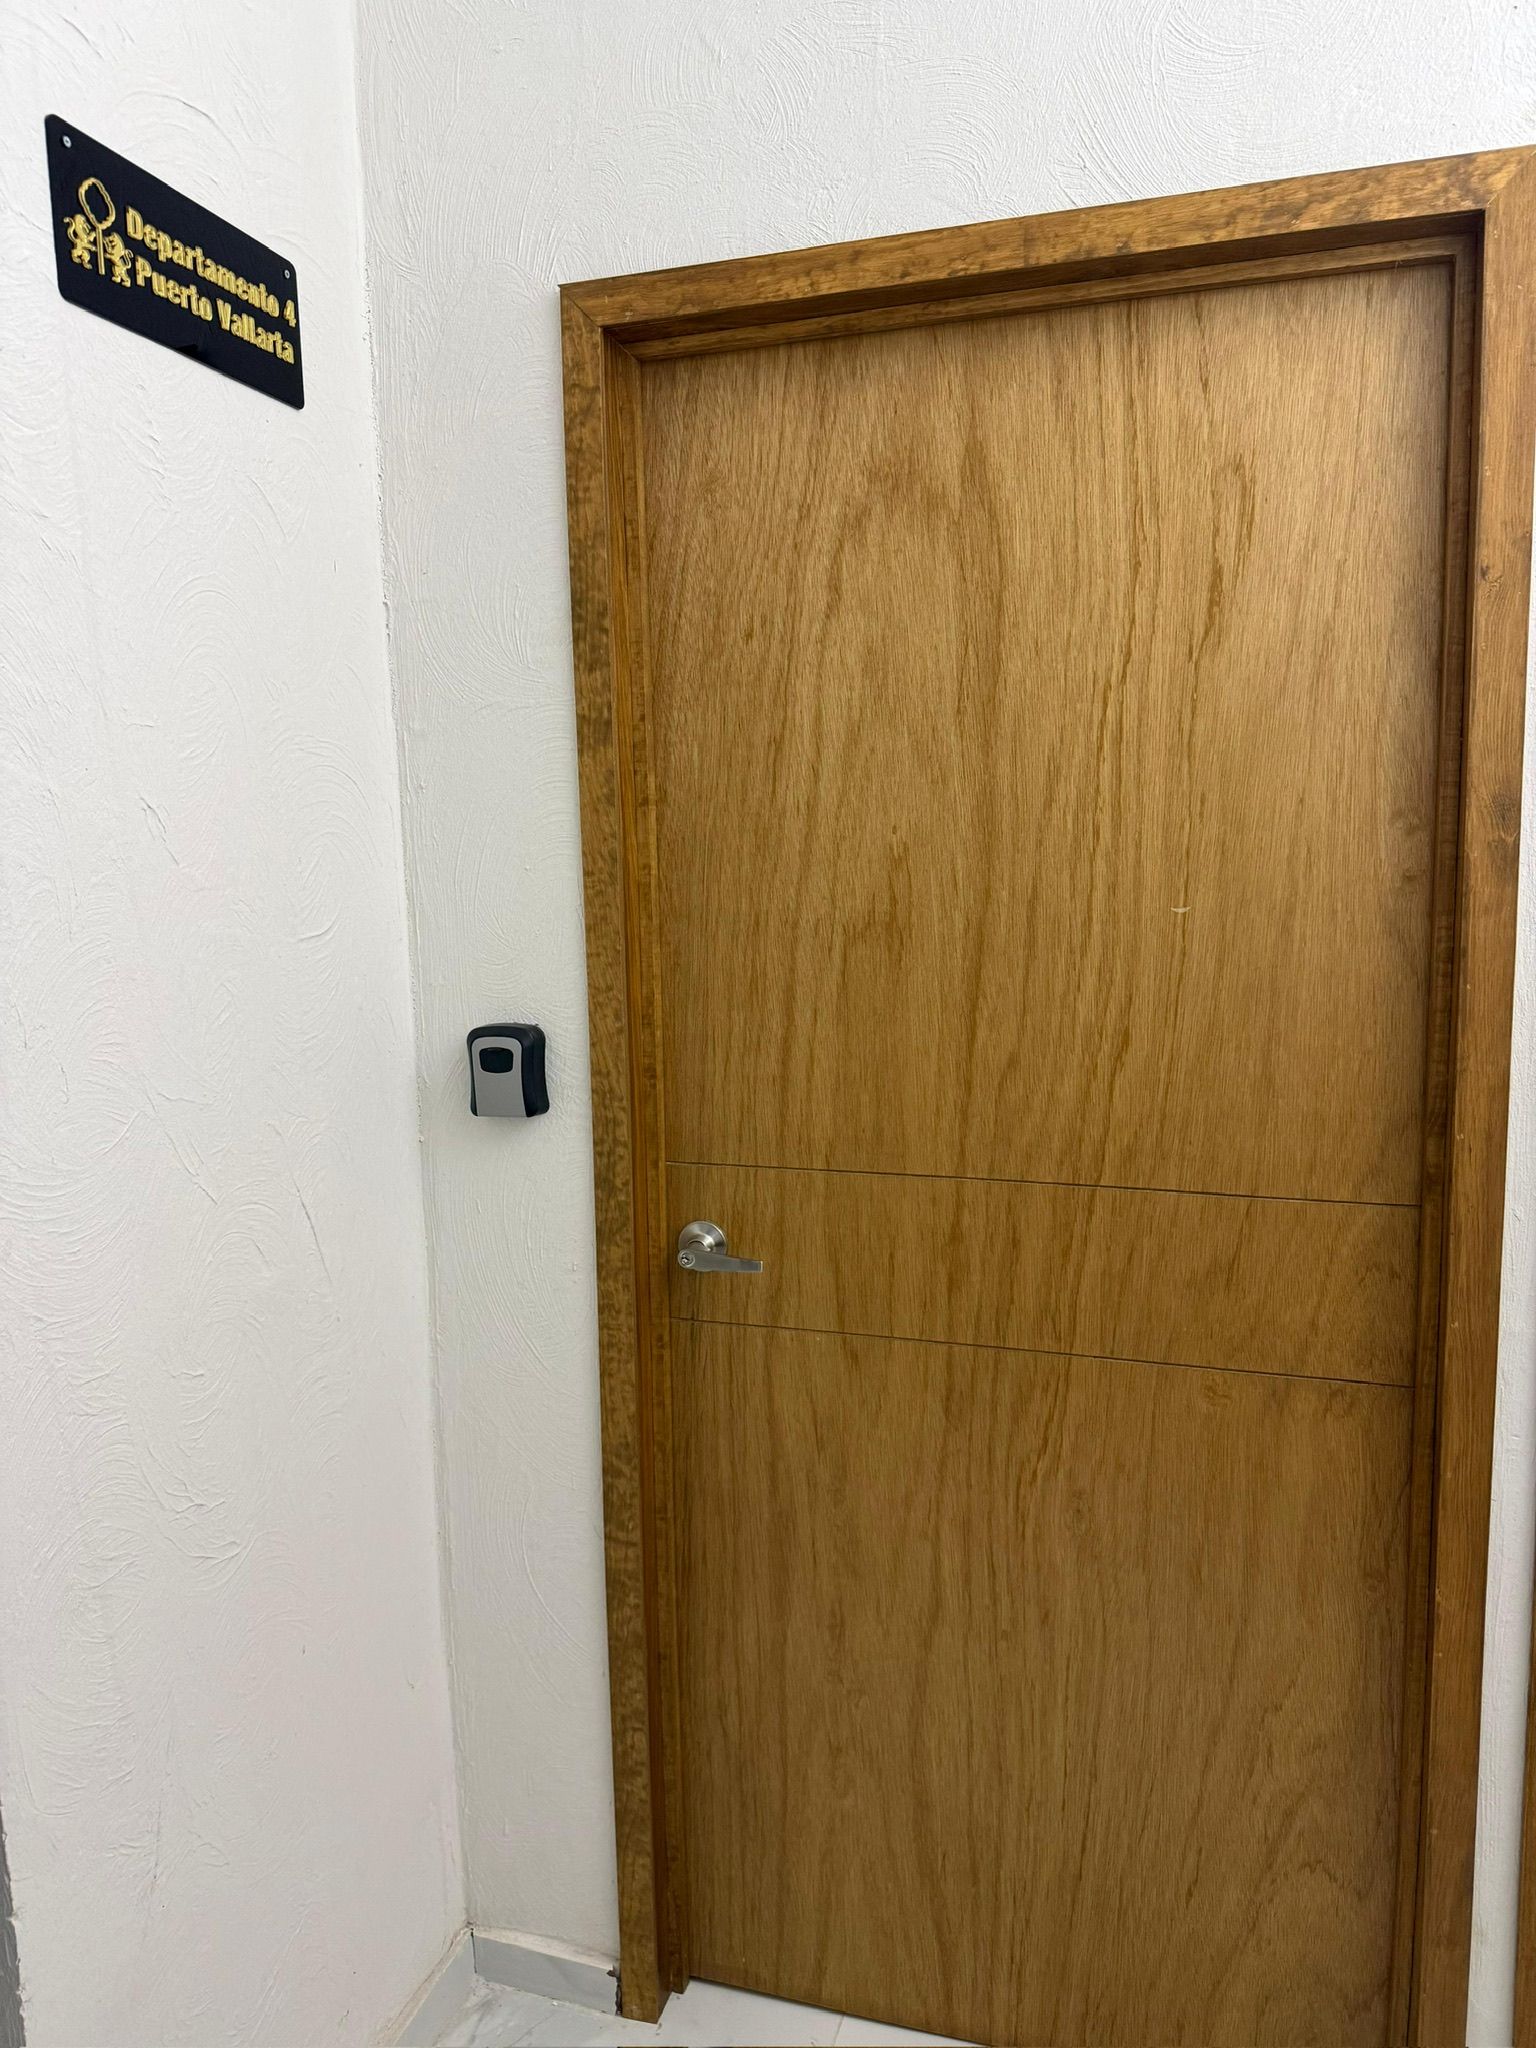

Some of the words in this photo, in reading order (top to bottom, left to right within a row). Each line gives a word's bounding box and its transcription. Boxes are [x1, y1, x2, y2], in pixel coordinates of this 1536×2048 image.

[126, 206, 279, 317] Departamento
[283, 299, 296, 327] 4
[135, 256, 213, 321] Puerto
[216, 299, 295, 364] Vallarta
